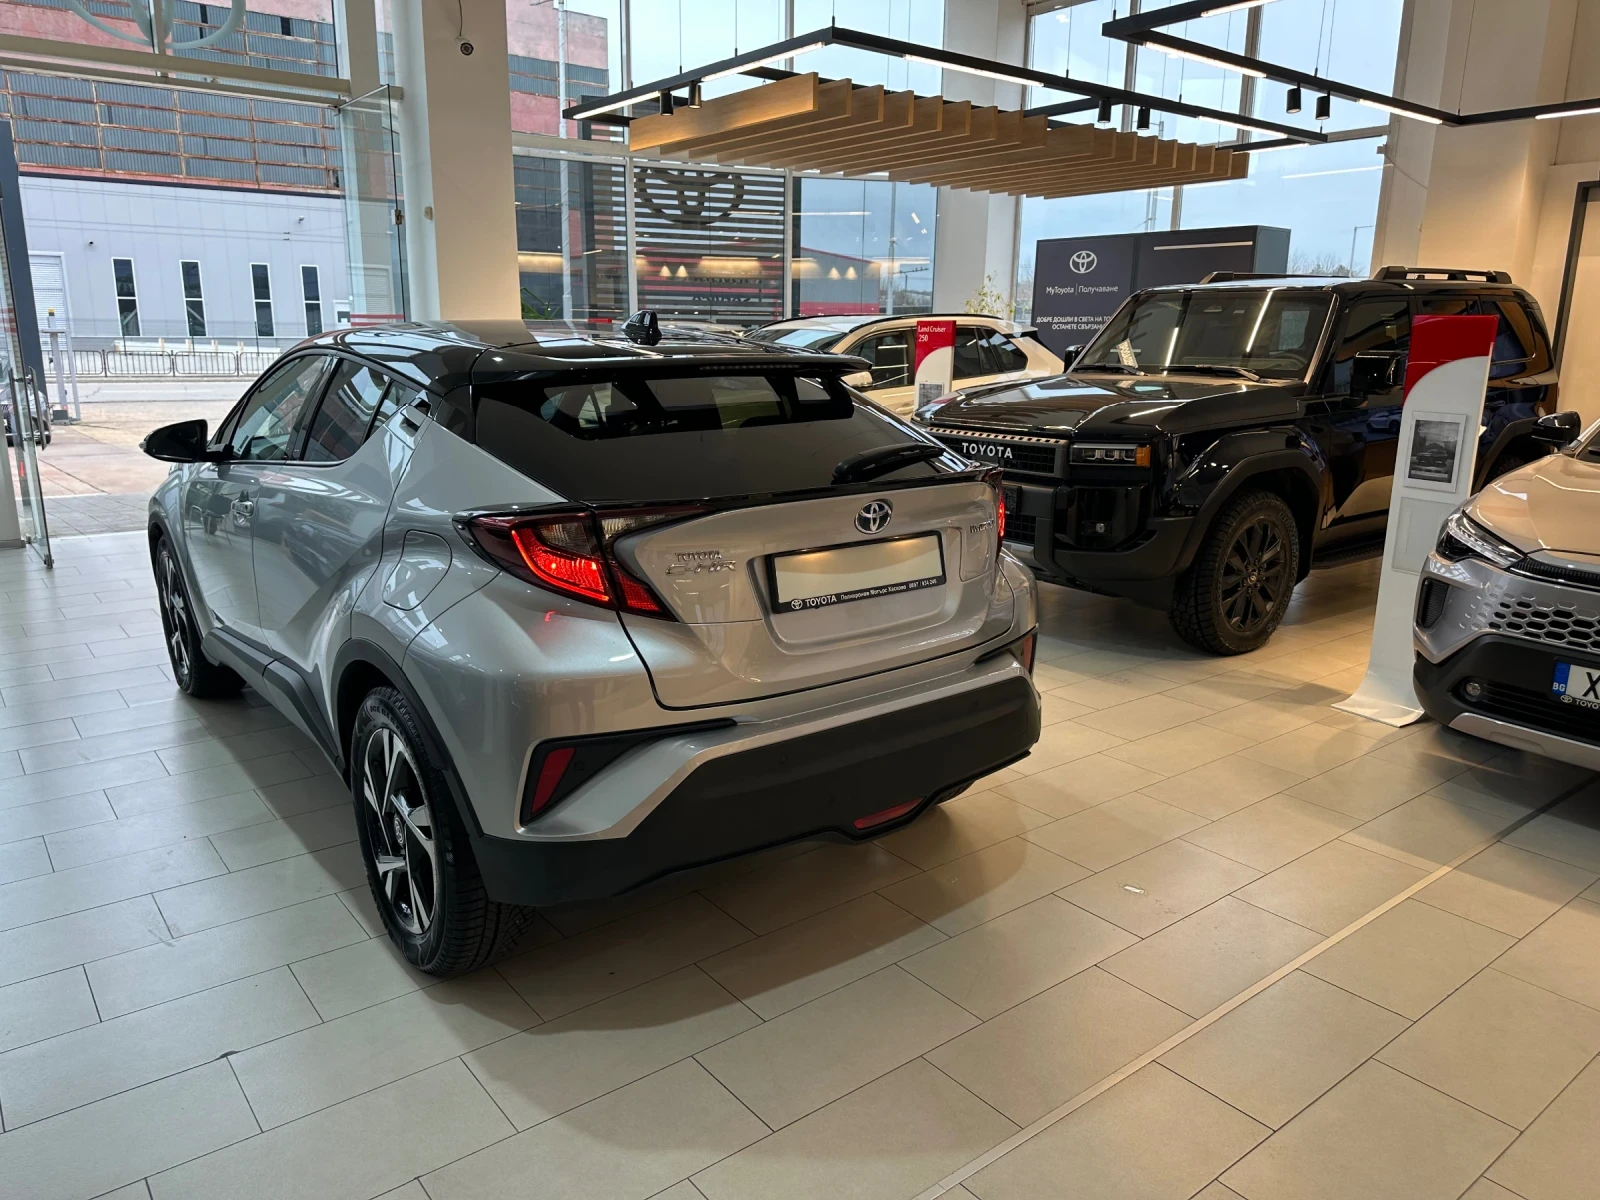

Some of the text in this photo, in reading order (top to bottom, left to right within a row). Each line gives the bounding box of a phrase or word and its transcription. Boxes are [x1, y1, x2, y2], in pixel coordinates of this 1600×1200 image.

[1046, 285, 1119, 295] MyToyota Получаване
[918, 334, 929, 342] 250
[962, 442, 1013, 459] TOYOTA
[675, 550, 722, 561] TOYOTA
[665, 560, 736, 576] C-HR
[805, 595, 837, 607] TOYOTA
[1552, 682, 1566, 692] BG
